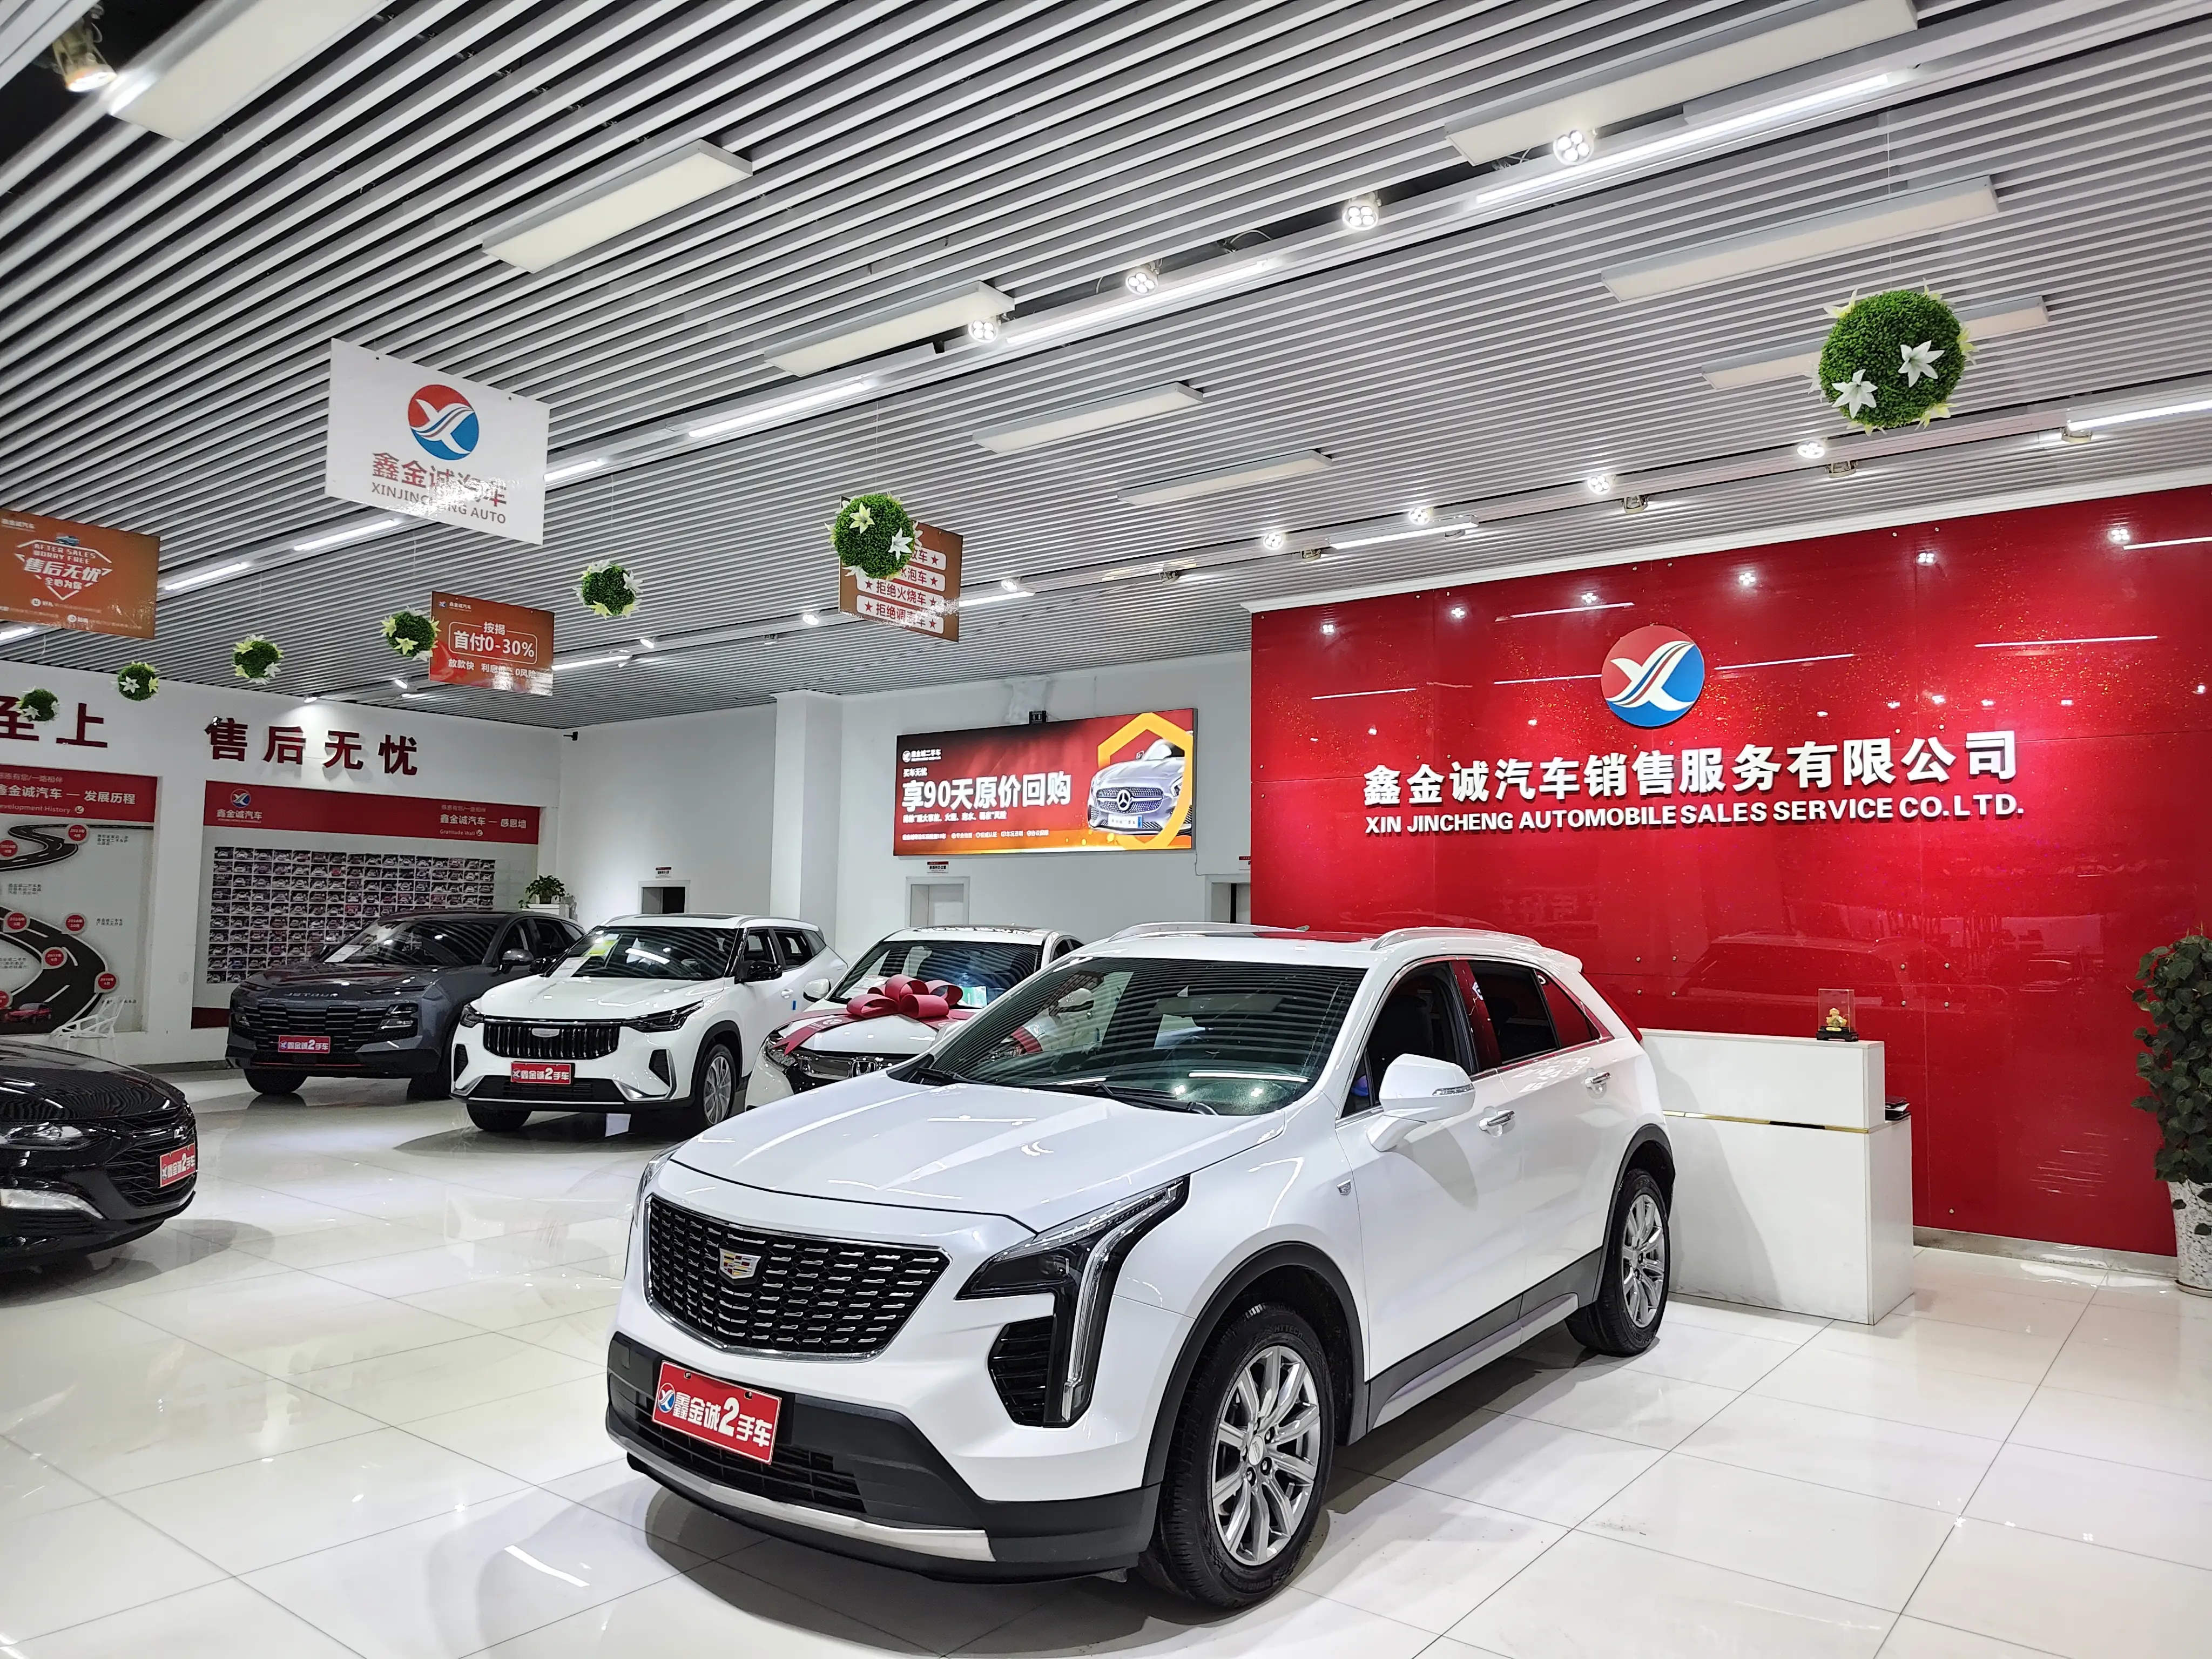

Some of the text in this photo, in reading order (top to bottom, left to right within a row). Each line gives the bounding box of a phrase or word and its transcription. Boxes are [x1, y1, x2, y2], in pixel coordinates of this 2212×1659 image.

[470, 507, 507, 524] AUTO
[34, 543, 97, 559] AFTER SALES
[67, 555, 91, 565] FREE
[24, 557, 101, 582] 售后无忧
[876, 580, 927, 605] 拒绝火烧车
[483, 622, 505, 635] 按揭
[454, 630, 535, 658] 首付0-30%
[448, 658, 475, 670] 放款快
[515, 668, 536, 678] 0风险
[204, 717, 418, 776] 售后无忧
[1363, 730, 2017, 806] 鑫金诚汽车销售服务有限公司
[84, 790, 136, 805] 发展历程
[901, 771, 1072, 812] 享90天原价回购
[43, 806, 71, 814] History
[1365, 815, 1402, 834] XIN
[1406, 812, 1514, 833] JINCHENG
[1519, 805, 1677, 830] AUTOMOBILE
[1681, 801, 1767, 825] SALES
[1772, 798, 1893, 821] SERVICE
[501, 818, 527, 829] 感恩墙
[287, 1039, 329, 1050] 鑫金诚2手车
[521, 1067, 569, 1080] 鑫金诚2手车
[672, 1391, 773, 1447] 鑫金诚2手车
